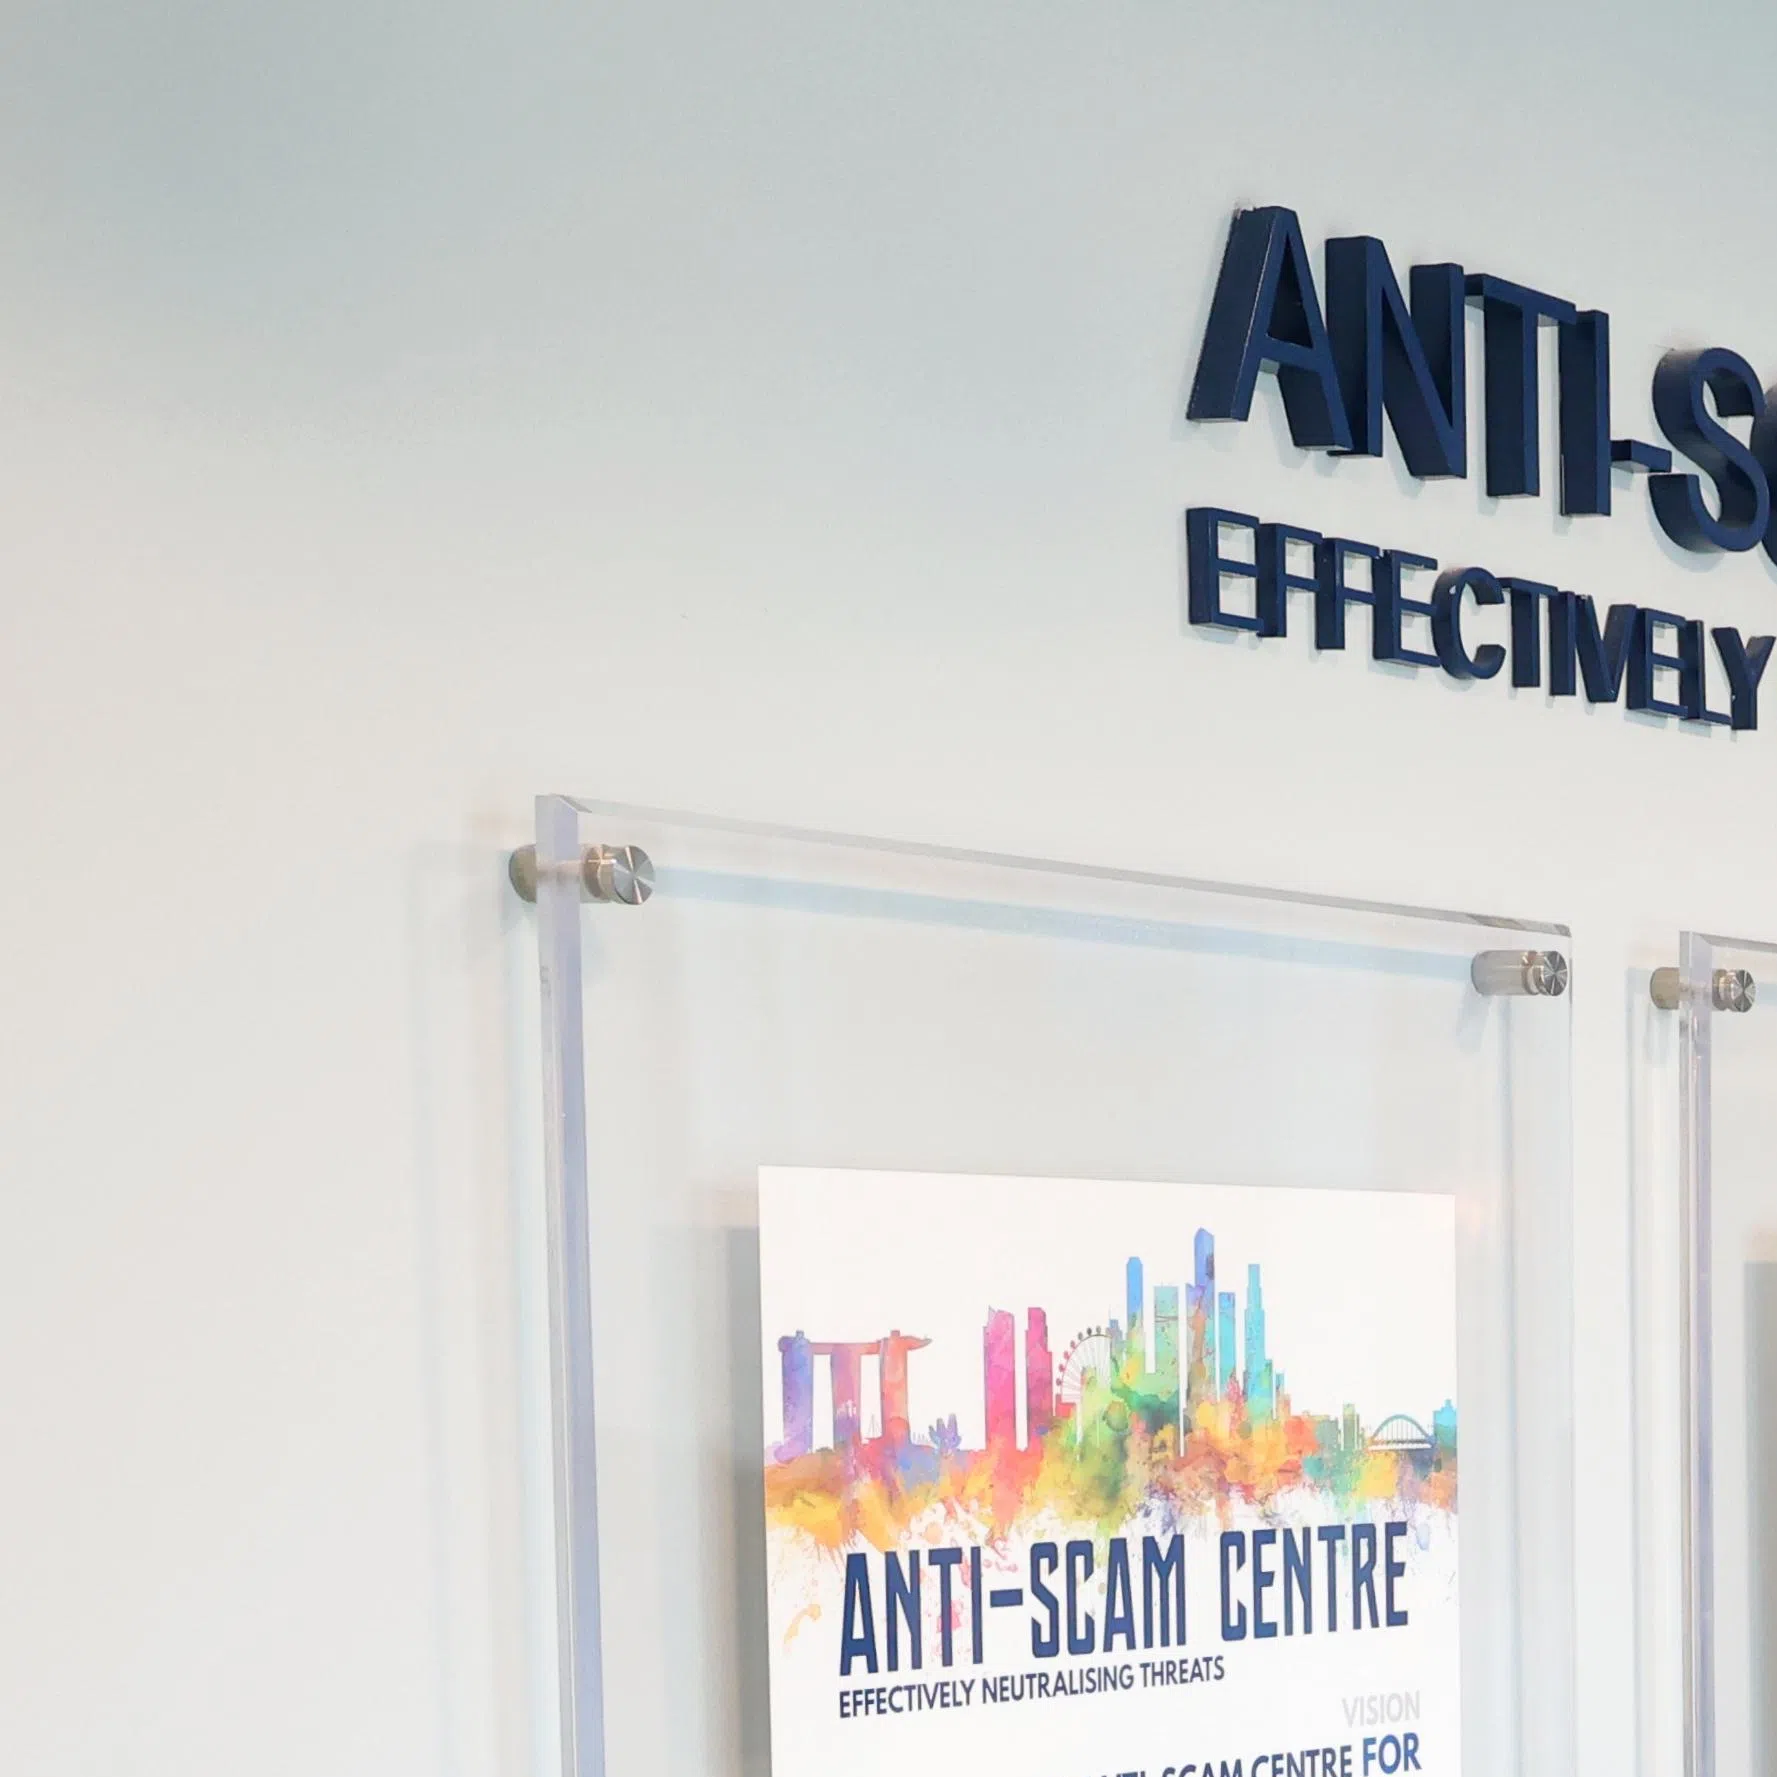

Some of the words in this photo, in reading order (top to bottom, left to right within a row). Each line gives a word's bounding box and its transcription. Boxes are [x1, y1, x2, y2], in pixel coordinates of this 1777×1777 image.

[1187, 506, 1776, 731] EFFECTIVELY
[840, 1534, 1186, 1676] ANTI-SCAM
[1219, 1521, 1409, 1642] CENTRE
[839, 1678, 974, 1718] EFFECTIVELY
[982, 1664, 1134, 1703] NEUTRALISING
[1139, 1656, 1225, 1685] THREATS
[1342, 1691, 1420, 1728] VISION
[1362, 1732, 1421, 1777] FOR
